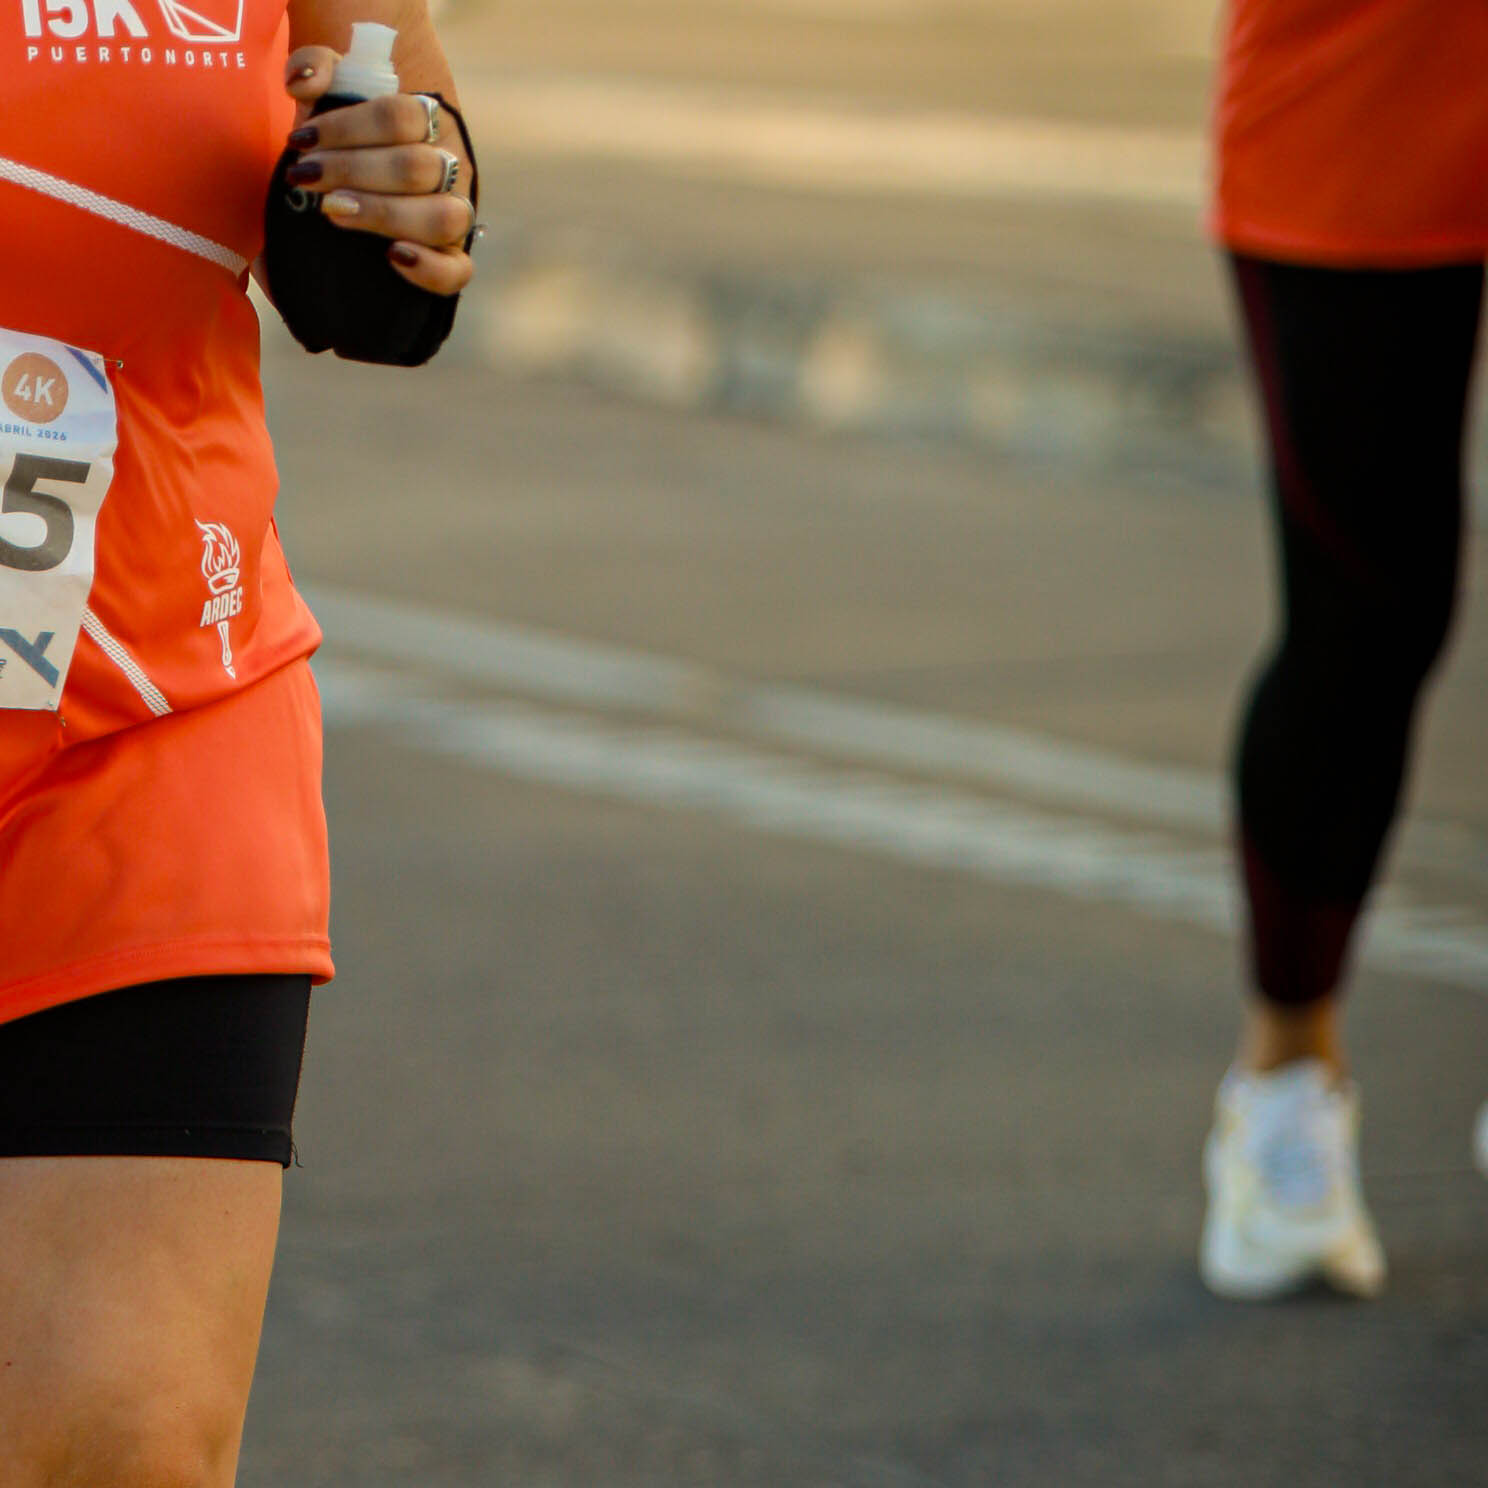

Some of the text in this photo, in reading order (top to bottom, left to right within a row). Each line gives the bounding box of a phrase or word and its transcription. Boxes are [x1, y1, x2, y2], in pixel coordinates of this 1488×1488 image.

[13, 372, 55, 406] 4K
[37, 429, 67, 441] 2026
[200, 586, 243, 627] ARDEC
